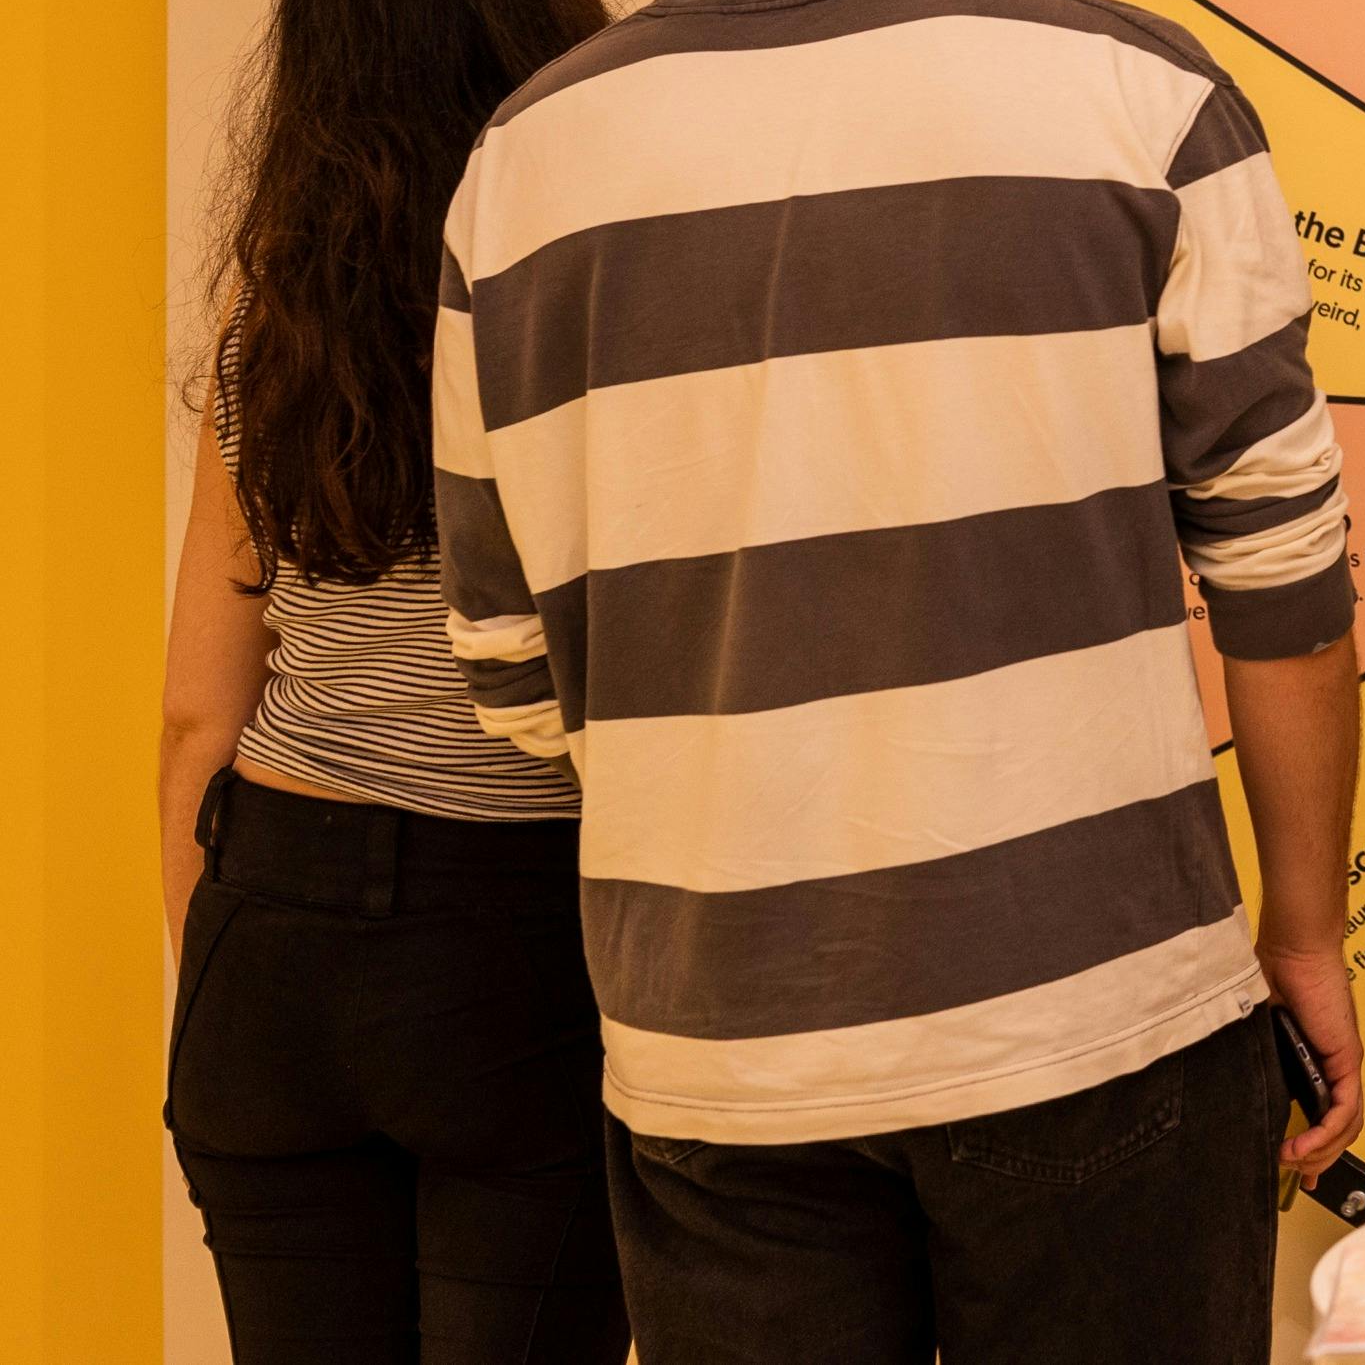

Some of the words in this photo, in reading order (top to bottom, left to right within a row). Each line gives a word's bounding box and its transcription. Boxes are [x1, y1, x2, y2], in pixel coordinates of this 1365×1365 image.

[1294, 210, 1345, 249] the
[1307, 258, 1337, 283] for
[1339, 268, 1364, 293] its
